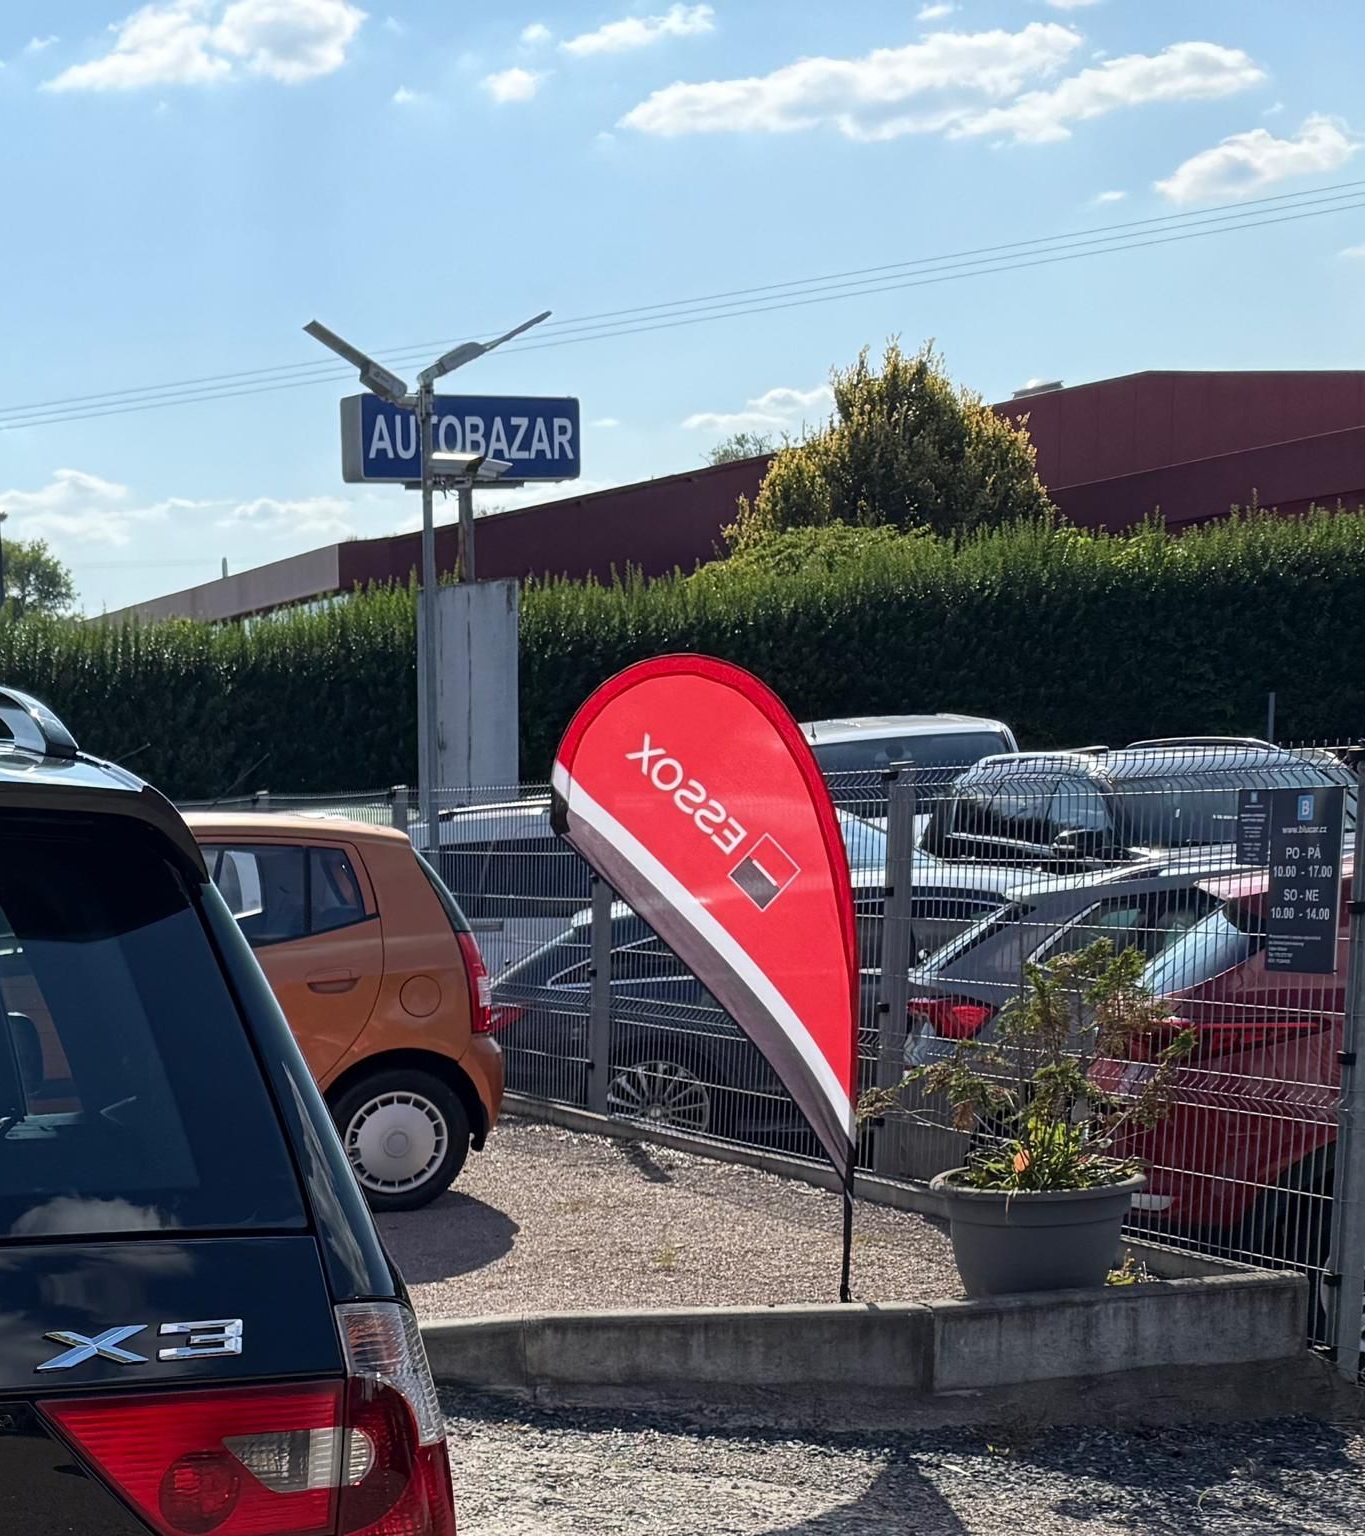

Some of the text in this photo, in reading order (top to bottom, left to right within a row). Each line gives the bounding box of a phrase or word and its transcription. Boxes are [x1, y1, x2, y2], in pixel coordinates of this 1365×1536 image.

[369, 414, 574, 460] AUOBAZAR
[1302, 800, 1310, 815] B
[1285, 847, 1300, 859] PO
[1308, 843, 1321, 859] PÁ
[1273, 865, 1297, 878] 10.00
[1309, 865, 1333, 878] 17.00
[1283, 888, 1298, 902] SO
[1305, 889, 1319, 902] NE
[1271, 907, 1295, 919] 10.00
[1306, 907, 1330, 920] 14.00
[35, 1318, 243, 1370] X3
